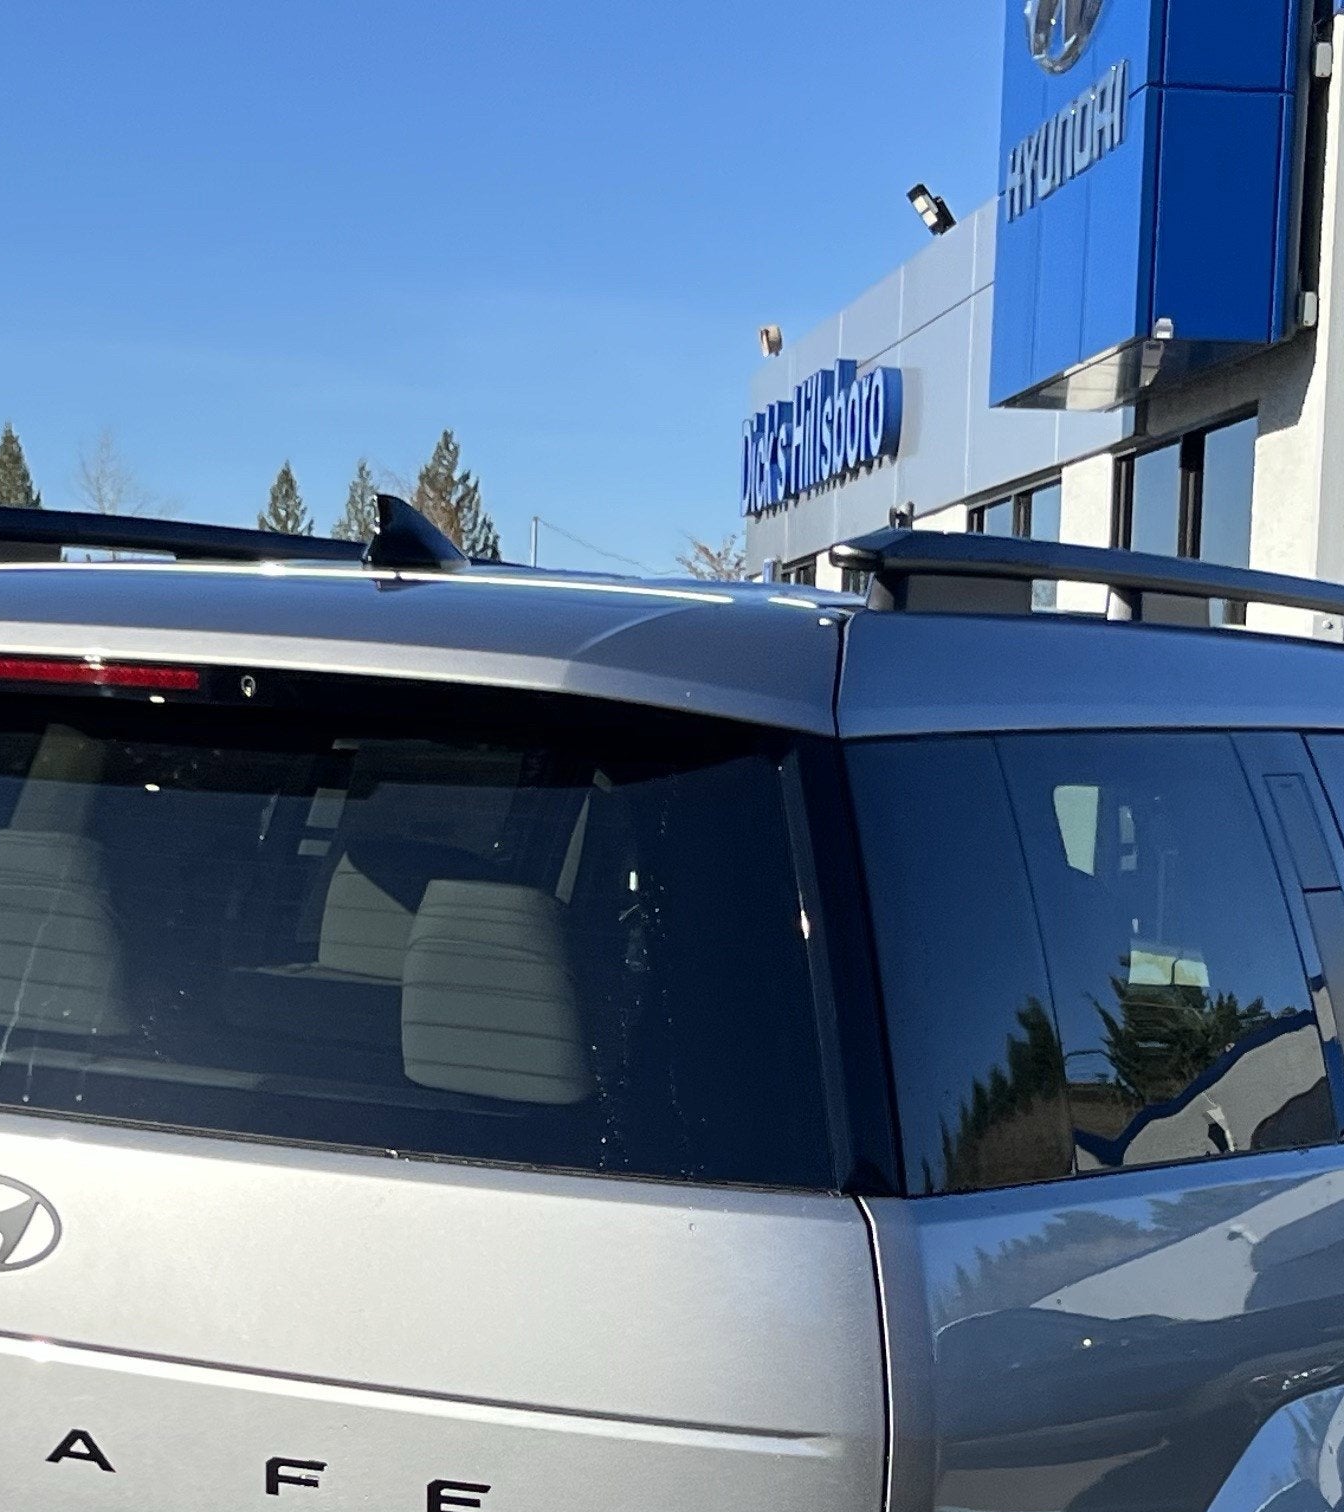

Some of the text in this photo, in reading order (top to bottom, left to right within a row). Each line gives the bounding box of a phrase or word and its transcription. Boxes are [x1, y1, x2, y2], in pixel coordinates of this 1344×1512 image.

[1008, 58, 1130, 223] HYUNDAI
[741, 360, 886, 517] Dick's Hillsboro
